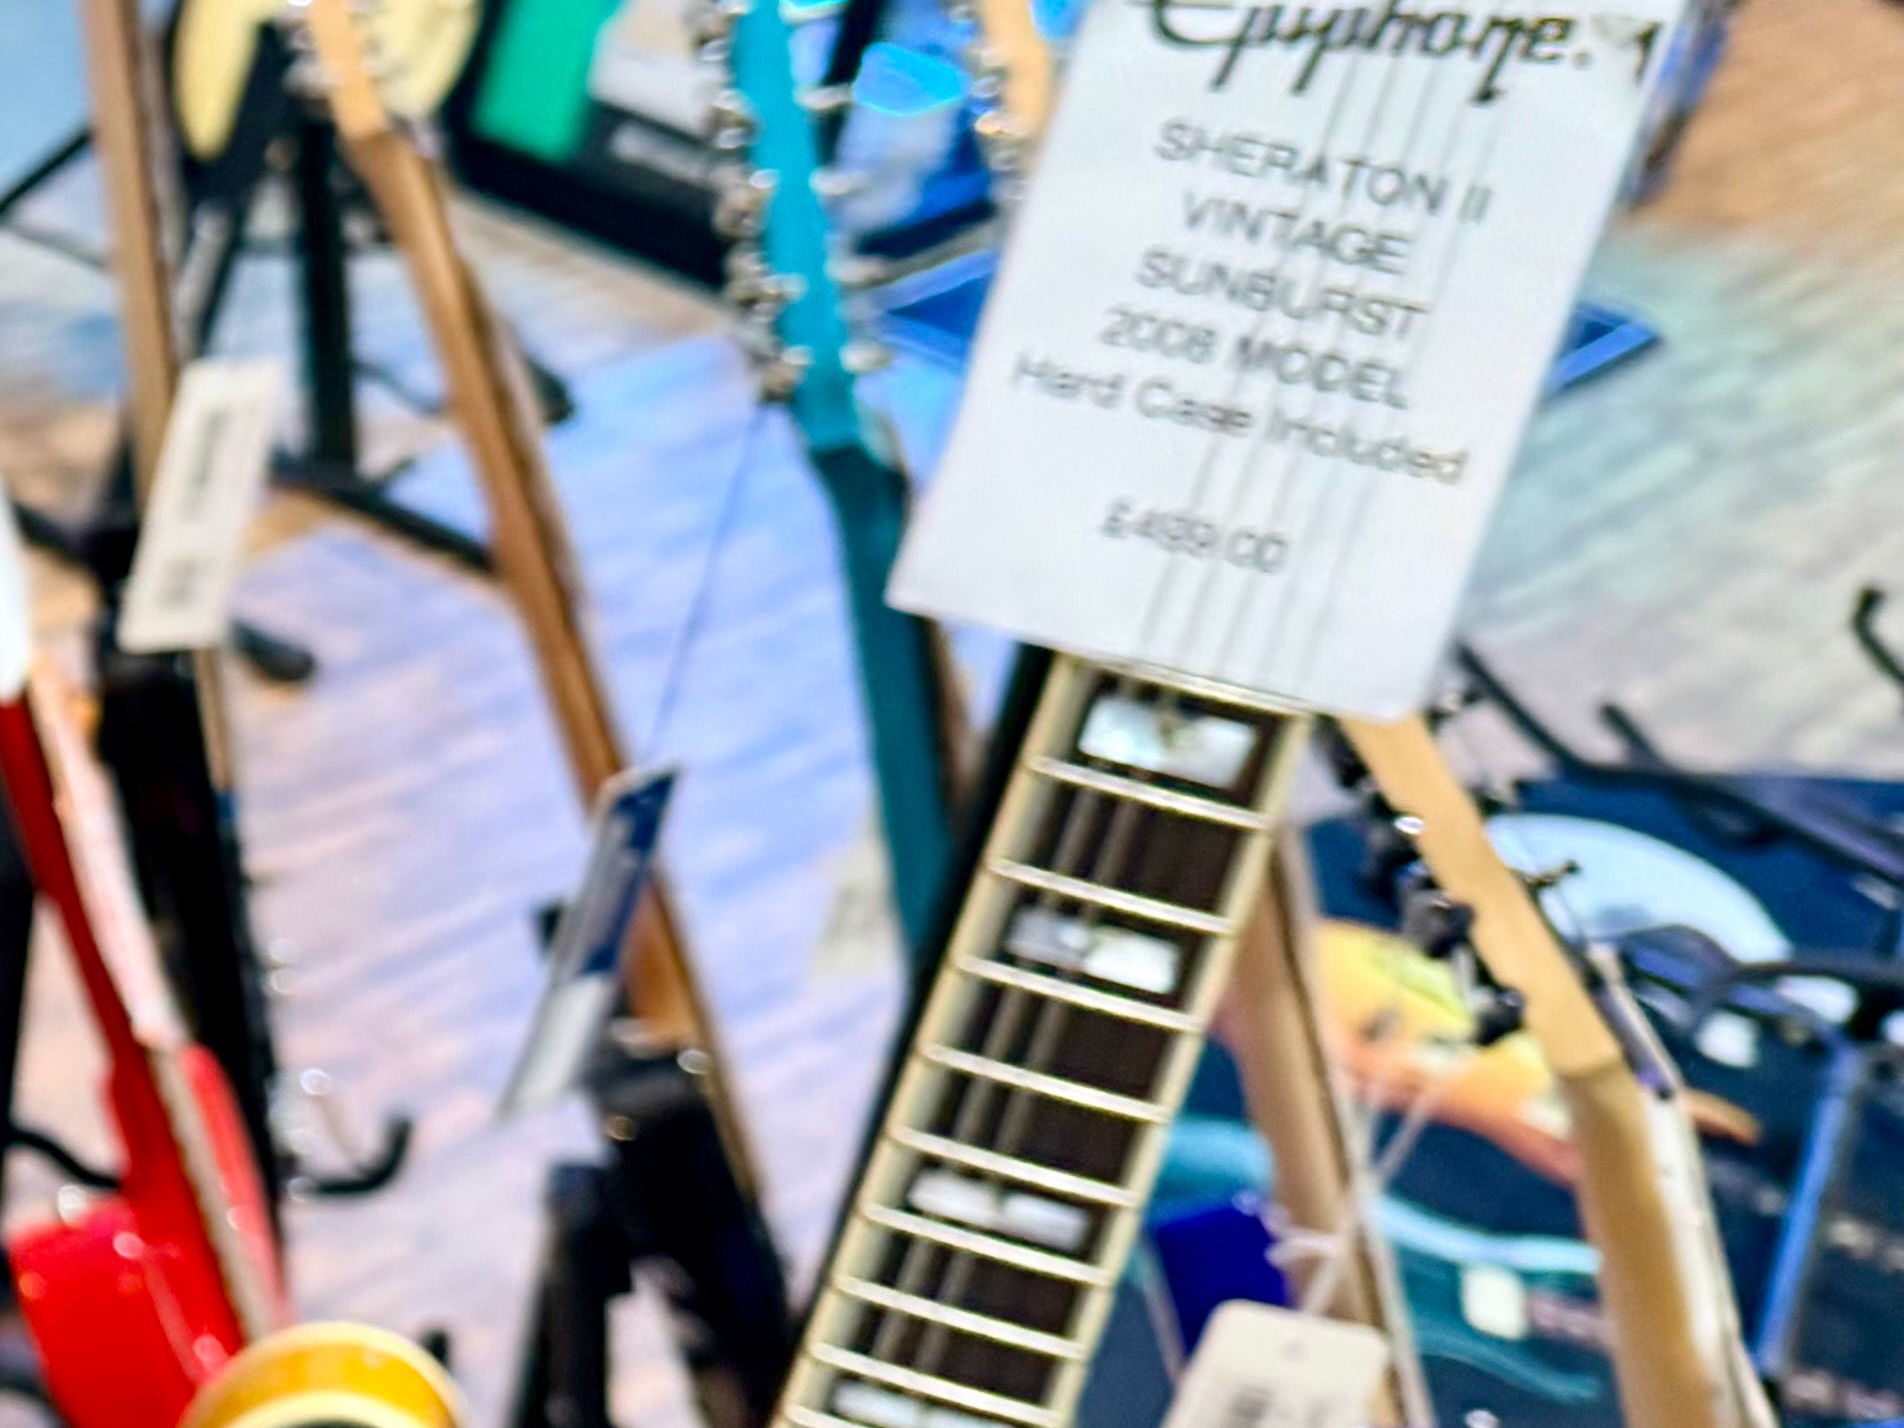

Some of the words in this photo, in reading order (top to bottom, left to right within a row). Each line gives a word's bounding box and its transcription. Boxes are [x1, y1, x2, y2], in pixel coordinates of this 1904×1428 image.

[1154, 118, 1449, 216] SHERATON
[1183, 190, 1416, 275] VINTAGE
[1137, 246, 1432, 340] SUNBURST
[1009, 353, 1127, 409] Hard
[1136, 378, 1252, 437] Case
[1266, 406, 1470, 486] Included
[1234, 335, 1409, 411] MODEL
